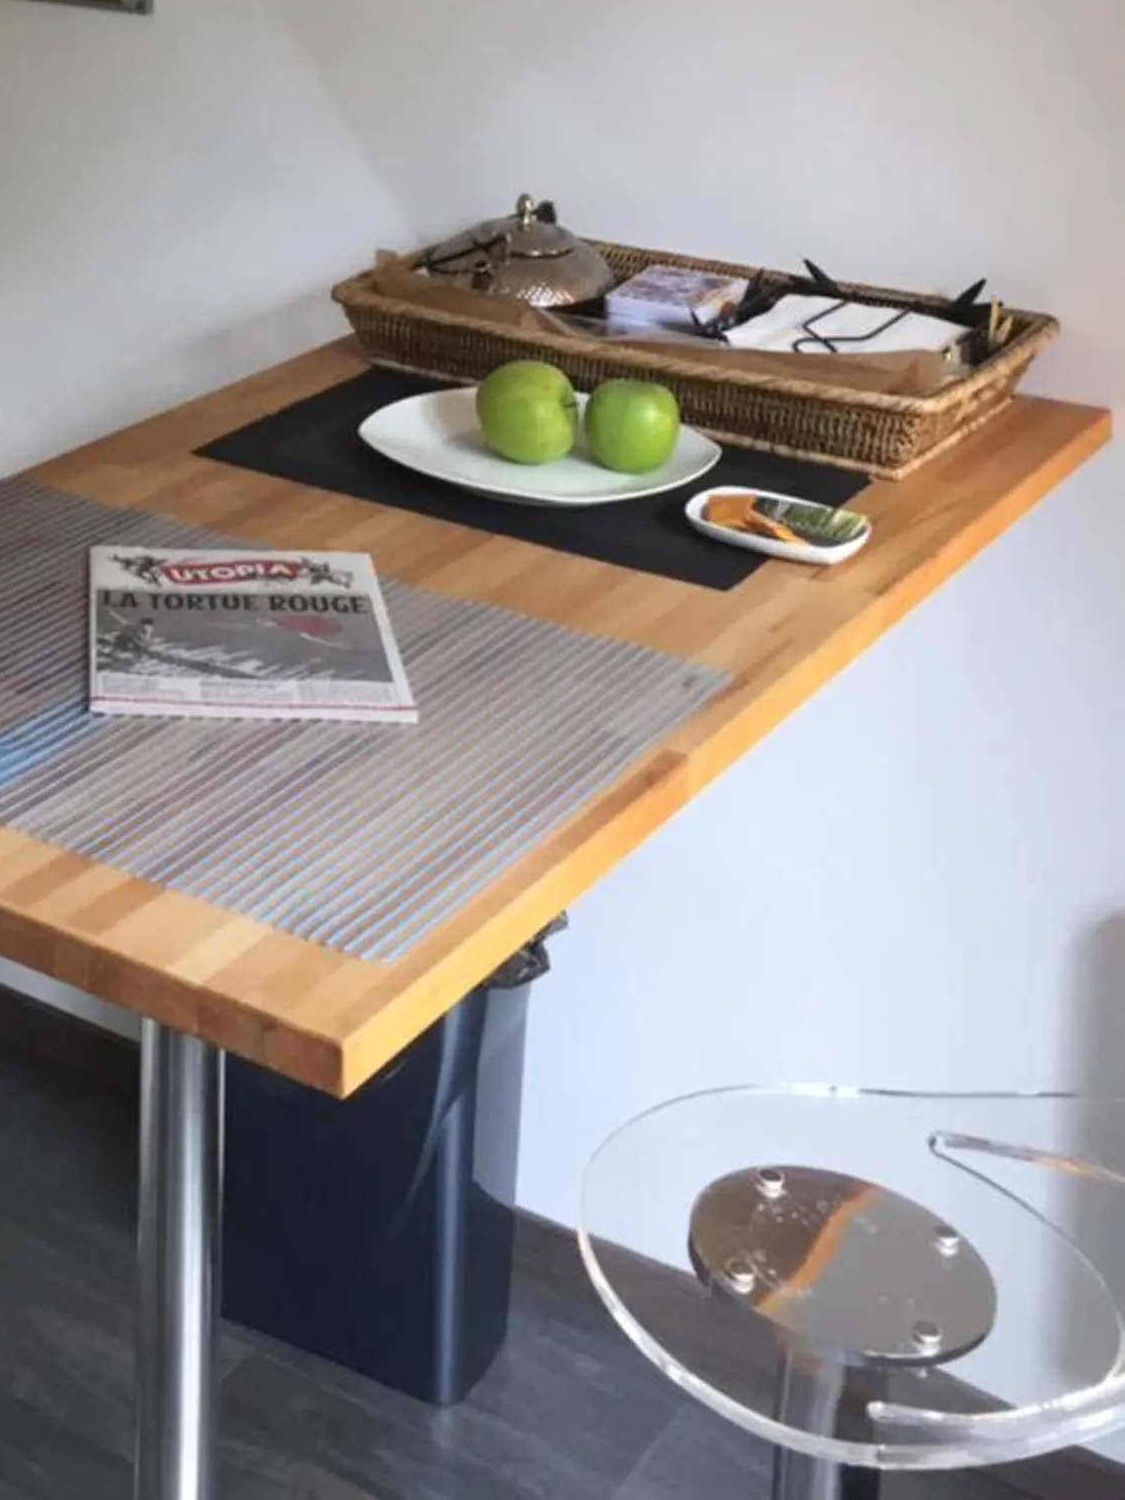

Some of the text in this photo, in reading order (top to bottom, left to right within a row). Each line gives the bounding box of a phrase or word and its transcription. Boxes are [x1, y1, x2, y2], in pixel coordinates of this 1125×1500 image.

[171, 561, 293, 583] UTOPIA
[102, 589, 370, 616] LA TORTUE ROUGE
